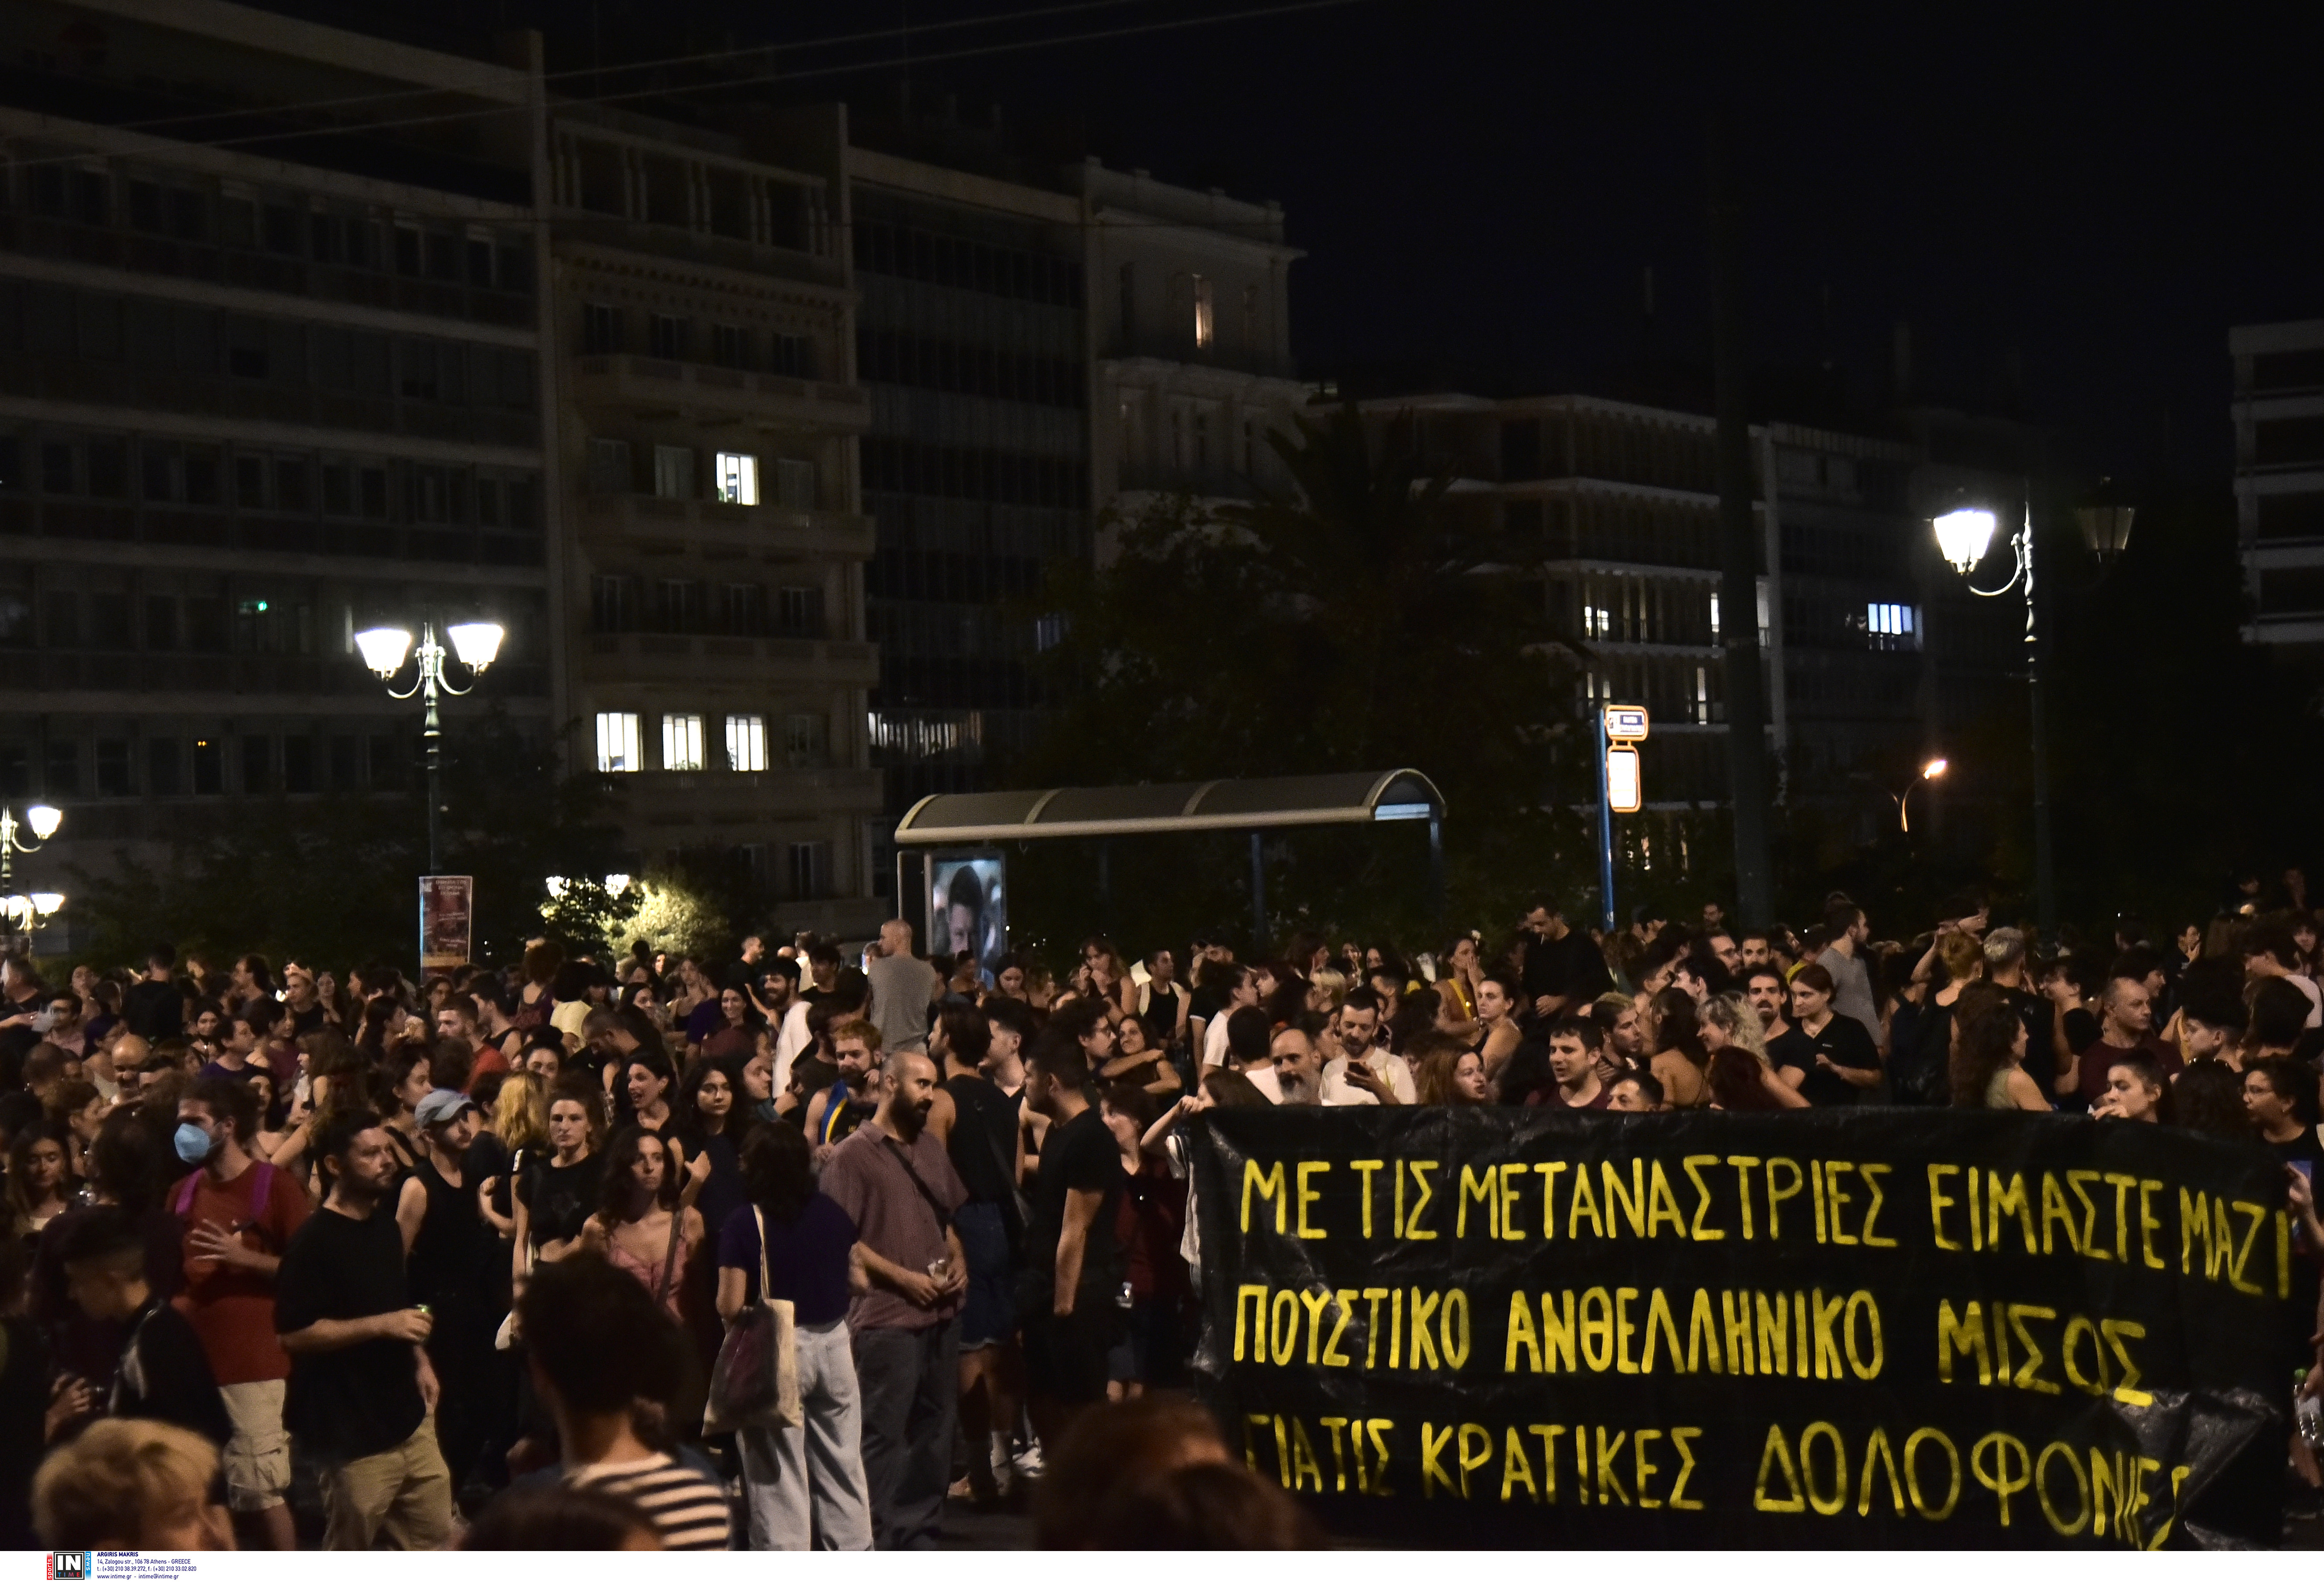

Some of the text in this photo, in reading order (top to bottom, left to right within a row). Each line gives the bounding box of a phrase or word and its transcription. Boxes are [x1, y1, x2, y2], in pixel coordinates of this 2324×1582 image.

[1240, 1154, 2293, 1300] ΜΕ ΤΙΣ ΜΕΤΑΝΑΣΤΡΙΕΣ ΕΙΜΑΣΤΕ ΜΑΖΙ
[1233, 1283, 2154, 1408] ΠΟΥΣΤΙΚΟ ΑΝΘΕΛΛΗΝΙΚΟ ΜΙΣΟΣ
[1420, 1421, 1705, 1511] ΚΡΑΤΙΚΕΣ
